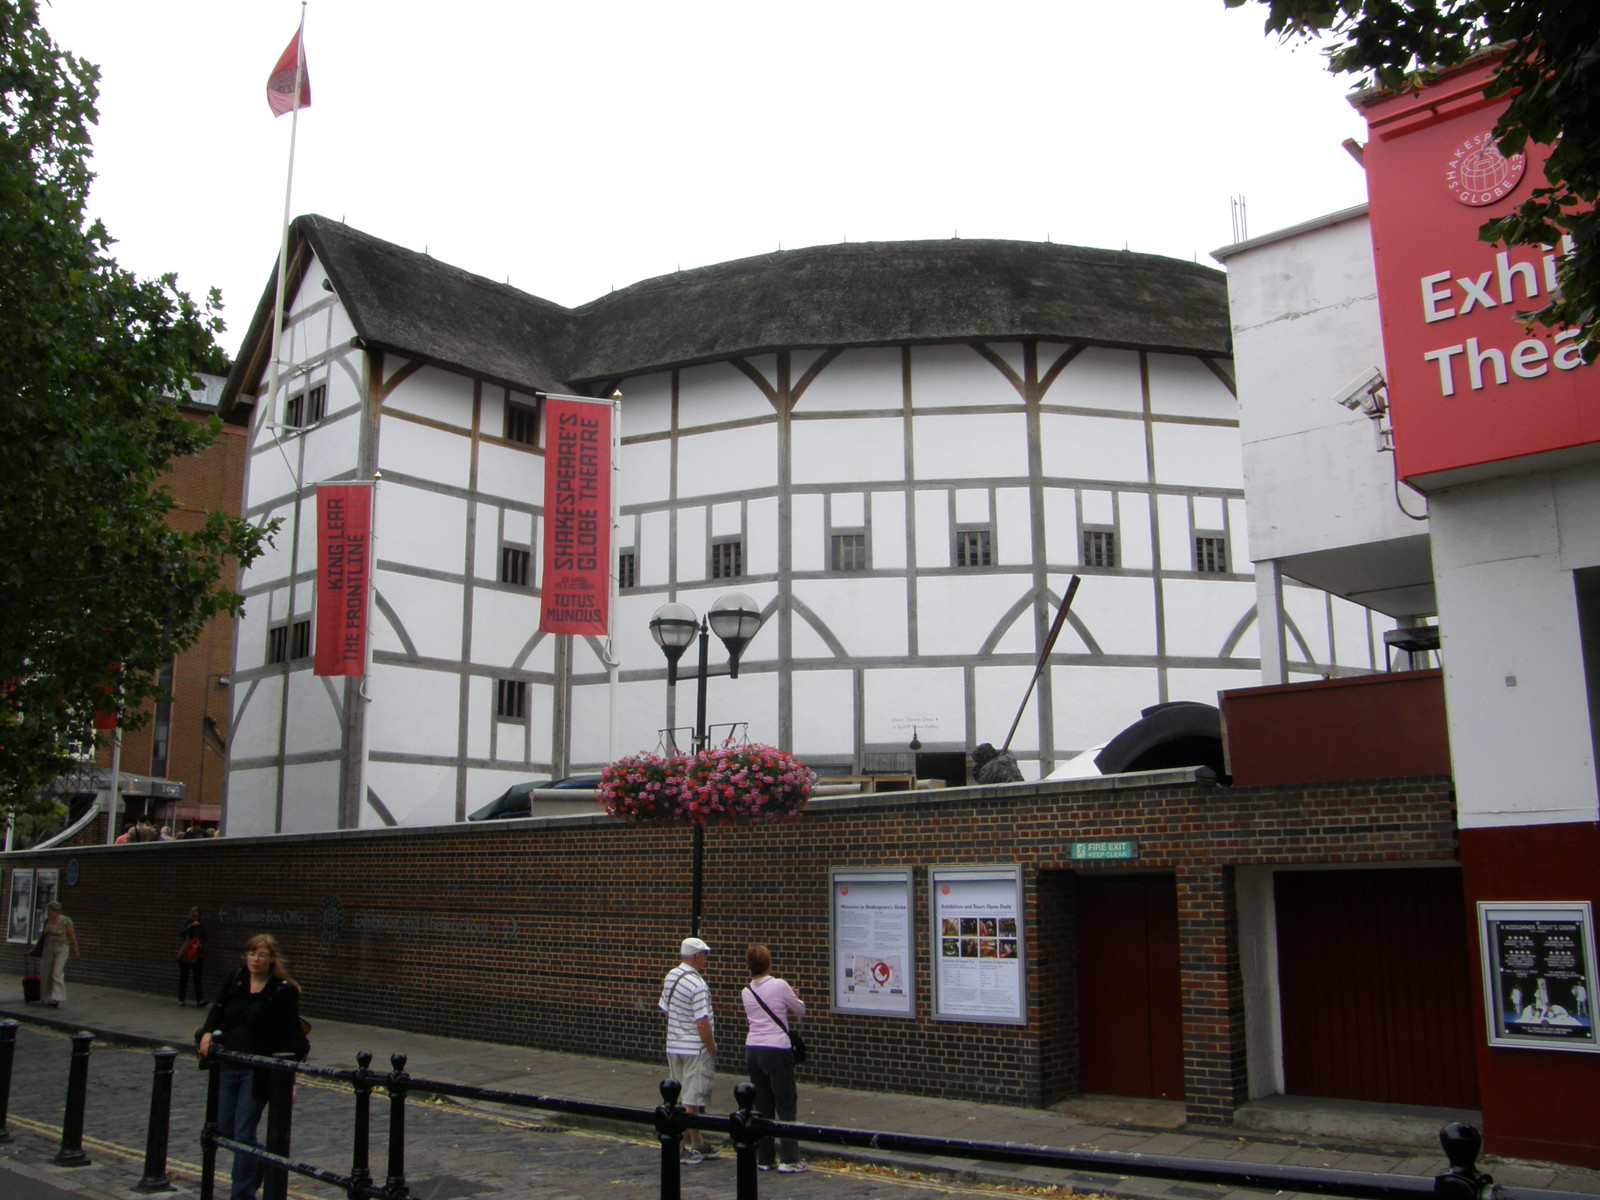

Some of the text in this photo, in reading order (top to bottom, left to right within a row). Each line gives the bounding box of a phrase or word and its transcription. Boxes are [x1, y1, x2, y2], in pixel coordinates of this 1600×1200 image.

[1446, 132, 1523, 190] SHAKESPE'S
[1459, 179, 1513, 204] GLOBE
[554, 412, 577, 570] SHAKESPEARE'S
[577, 418, 599, 570] GLOBE THEATRE
[327, 498, 345, 590] KING LEAR
[343, 534, 364, 663] THE FRONTLINE
[547, 608, 602, 622] MUNDUS
[554, 594, 594, 608] TOTUS
[1088, 842, 1127, 851] FIRE EXIT
[266, 909, 282, 924] Box
[284, 910, 309, 925] Office
